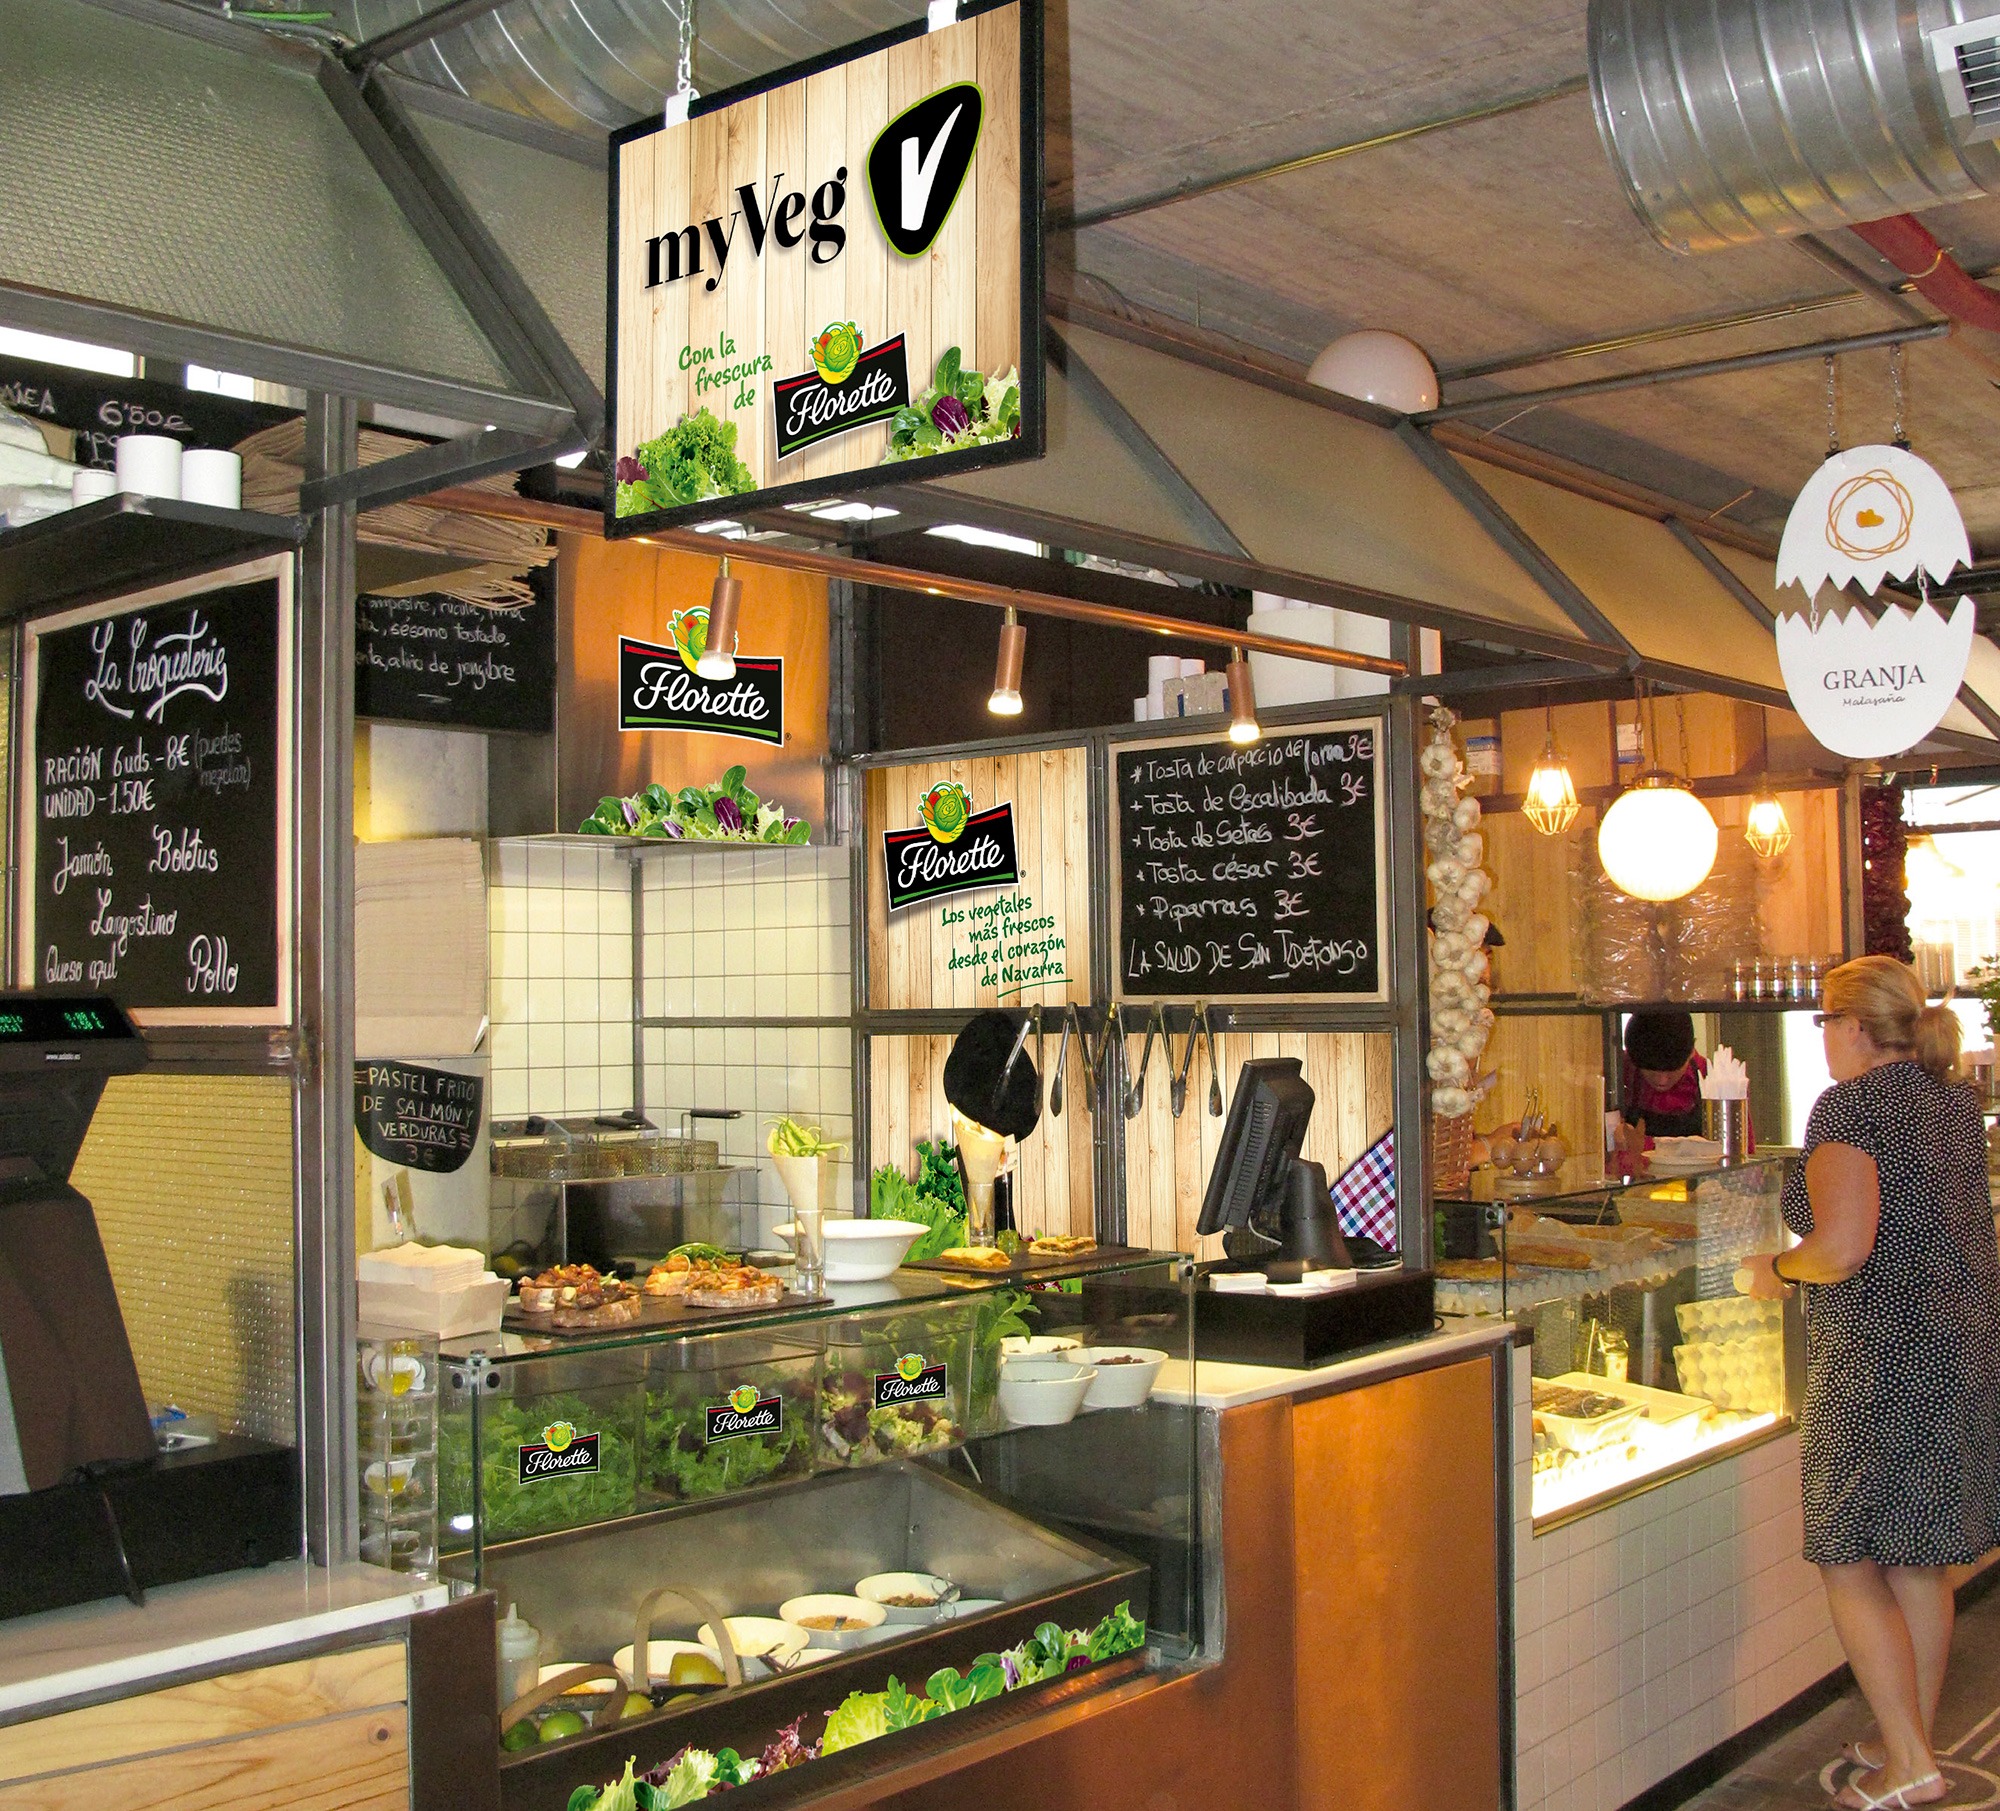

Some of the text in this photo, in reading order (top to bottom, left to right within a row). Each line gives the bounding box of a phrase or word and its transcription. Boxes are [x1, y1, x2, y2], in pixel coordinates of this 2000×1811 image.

[644, 166, 848, 292] myVeg
[678, 330, 736, 371] Con la
[694, 354, 774, 397] frescura
[733, 380, 756, 410] de
[785, 368, 897, 436] Florette
[391, 616, 449, 639] sésamo
[85, 620, 134, 719] La
[429, 651, 450, 674] de
[1823, 664, 1926, 692] GRANJA
[633, 661, 770, 720] Florette
[1843, 692, 1905, 707] Malasaña
[1147, 758, 1194, 782] Tosta
[1198, 752, 1213, 776] de
[1145, 791, 1195, 815] Tosta
[1203, 785, 1224, 812] de
[1141, 825, 1188, 852] Tosta
[1191, 821, 1214, 848] de
[54, 824, 219, 895] Jamón Boletus
[897, 834, 1005, 889] Florette
[1146, 857, 1206, 883] Tosta
[1212, 853, 1279, 882] césar
[91, 887, 178, 958] Langostino
[942, 892, 1033, 926] Los vegetales
[968, 915, 1055, 943] más frescos
[46, 941, 119, 989] Queso azul
[186, 934, 239, 994] Pollo
[948, 933, 1065, 970] desde el corazón
[981, 961, 1064, 987] de Navarra
[368, 1066, 476, 1101] PASTEL FRITO
[362, 1095, 474, 1128] DE SALMÓN Y
[378, 1121, 458, 1145] VERDURAS
[881, 1376, 941, 1401] Florette
[713, 1409, 776, 1434] Florette
[525, 1447, 593, 1475] Florette
